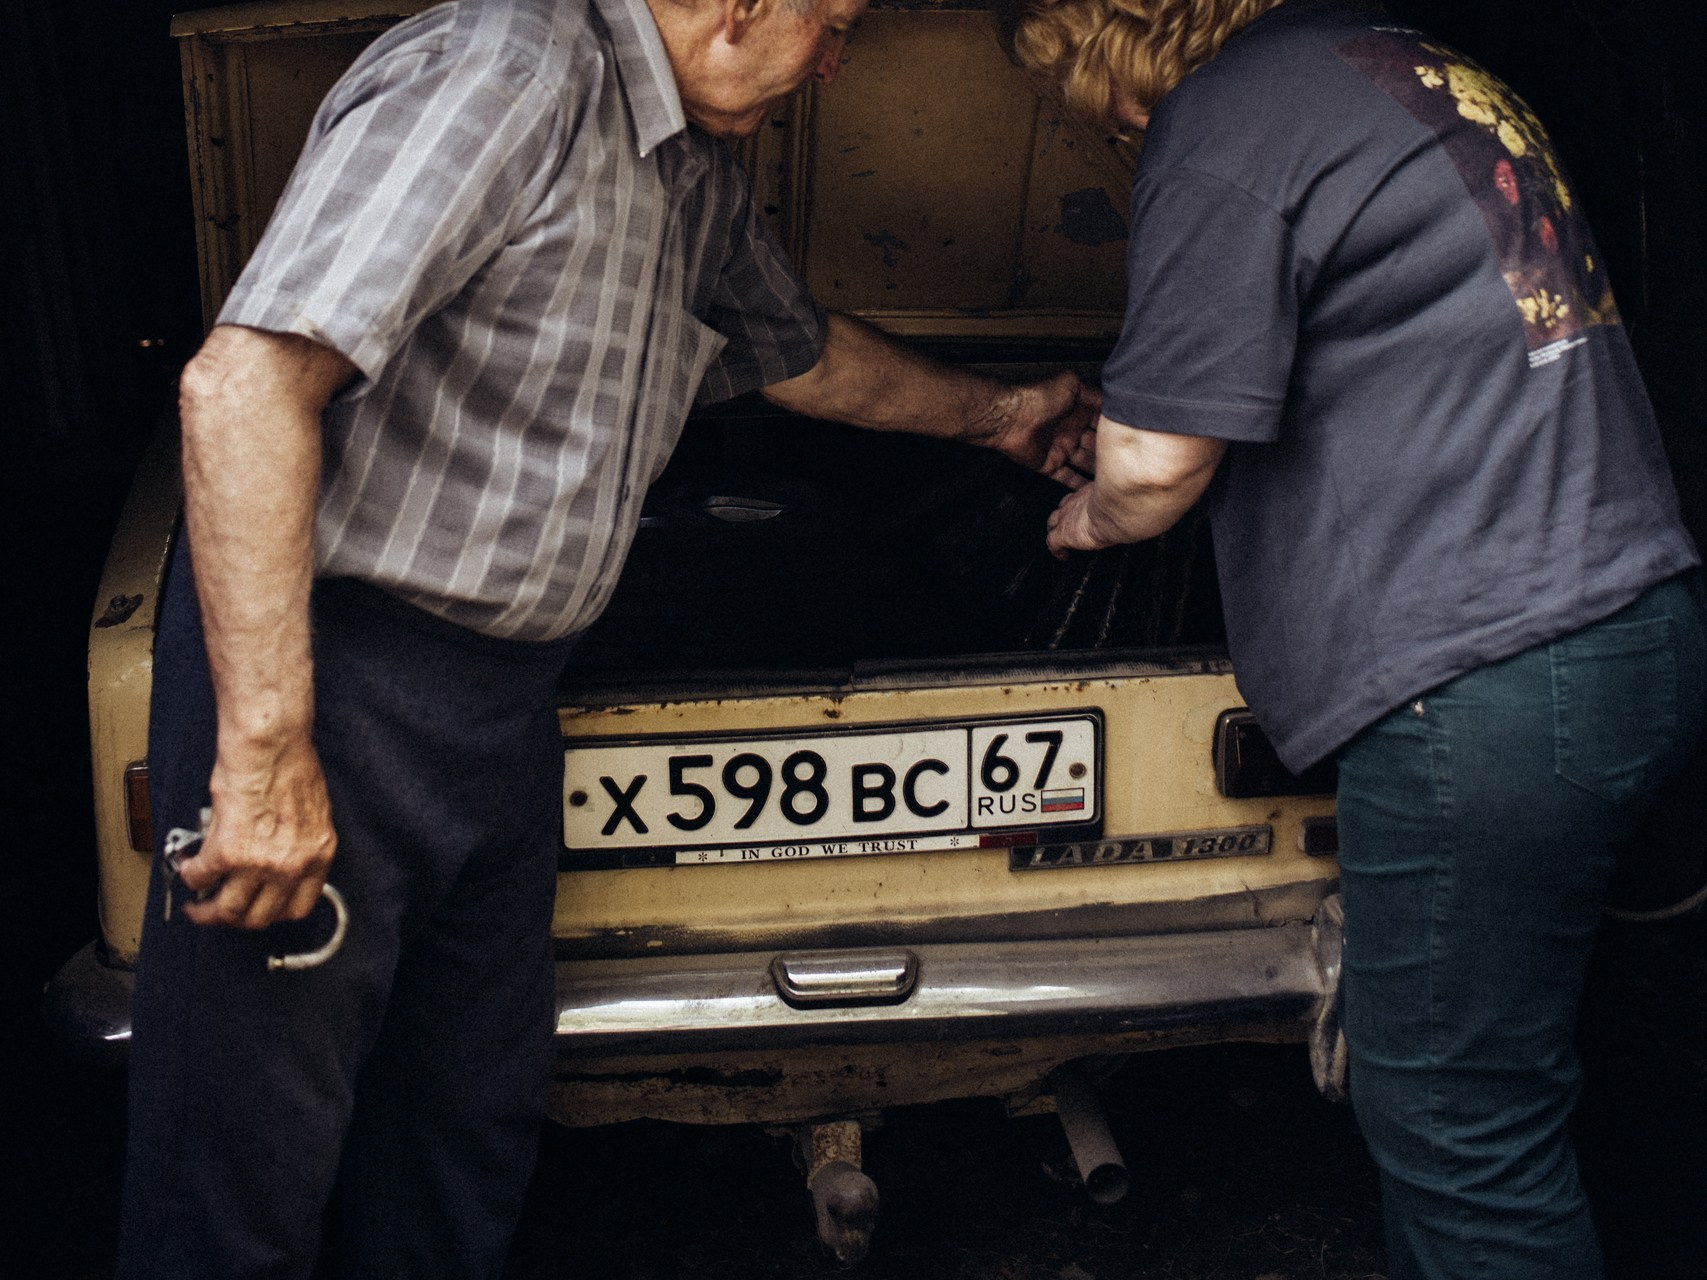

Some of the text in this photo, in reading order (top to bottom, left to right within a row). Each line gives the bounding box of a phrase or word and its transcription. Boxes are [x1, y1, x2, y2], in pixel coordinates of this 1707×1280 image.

[980, 730, 1064, 793] 67
[977, 792, 1037, 816] RUS
[741, 838, 919, 860] IN GOD WE TRUST
[1029, 832, 1258, 867] LADA 1300
